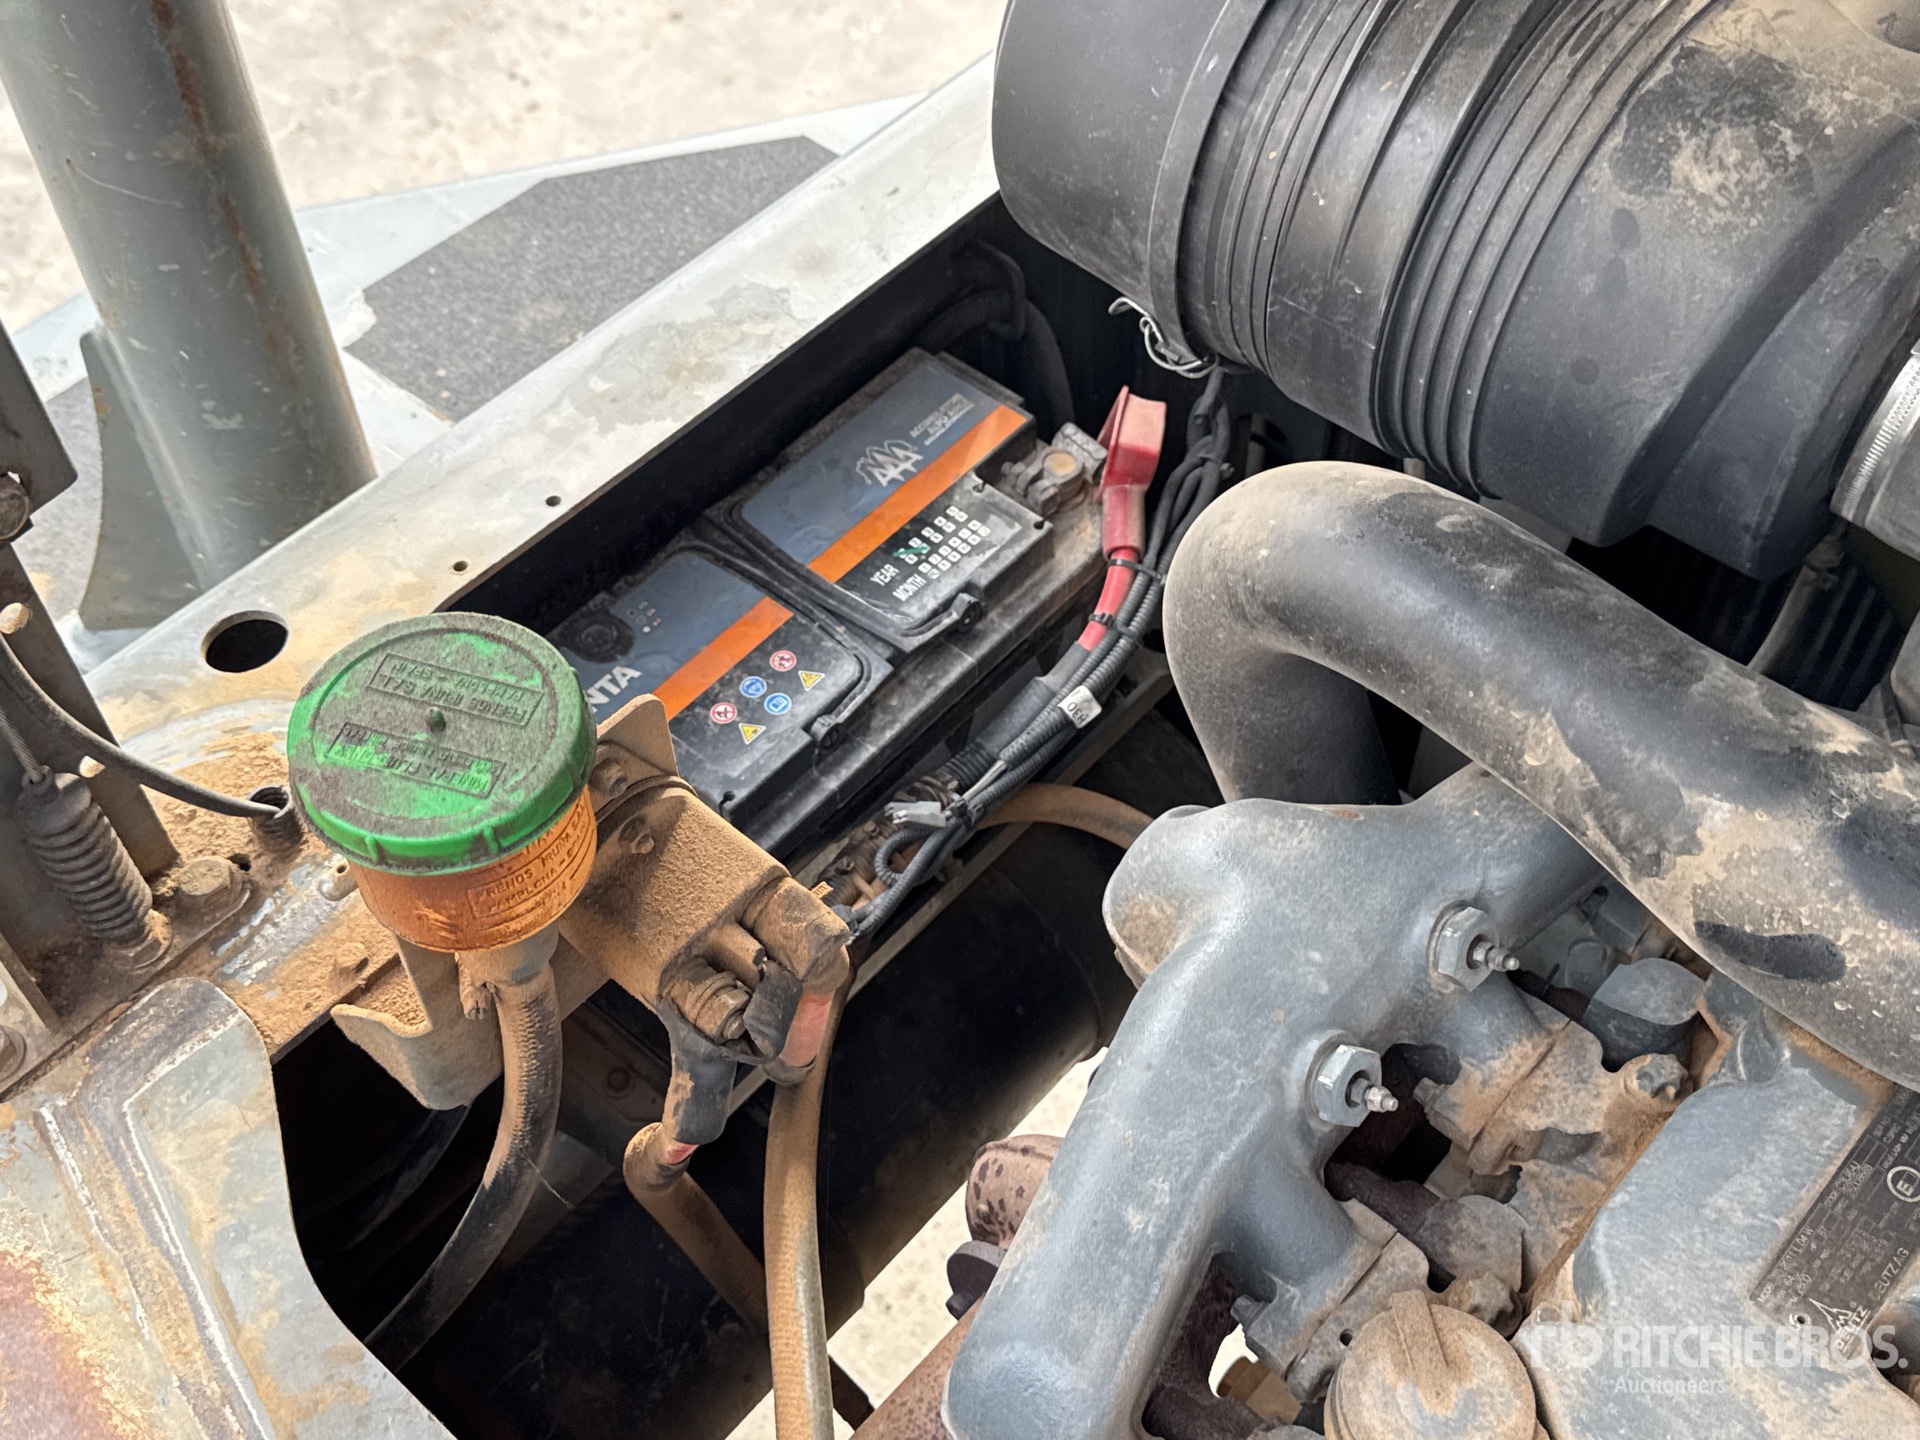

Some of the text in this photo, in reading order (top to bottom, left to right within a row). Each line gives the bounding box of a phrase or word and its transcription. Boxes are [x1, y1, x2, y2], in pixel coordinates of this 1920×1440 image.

[870, 564, 900, 586] YEAR
[892, 573, 927, 602] MONTH
[391, 662, 433, 679] SPAIN
